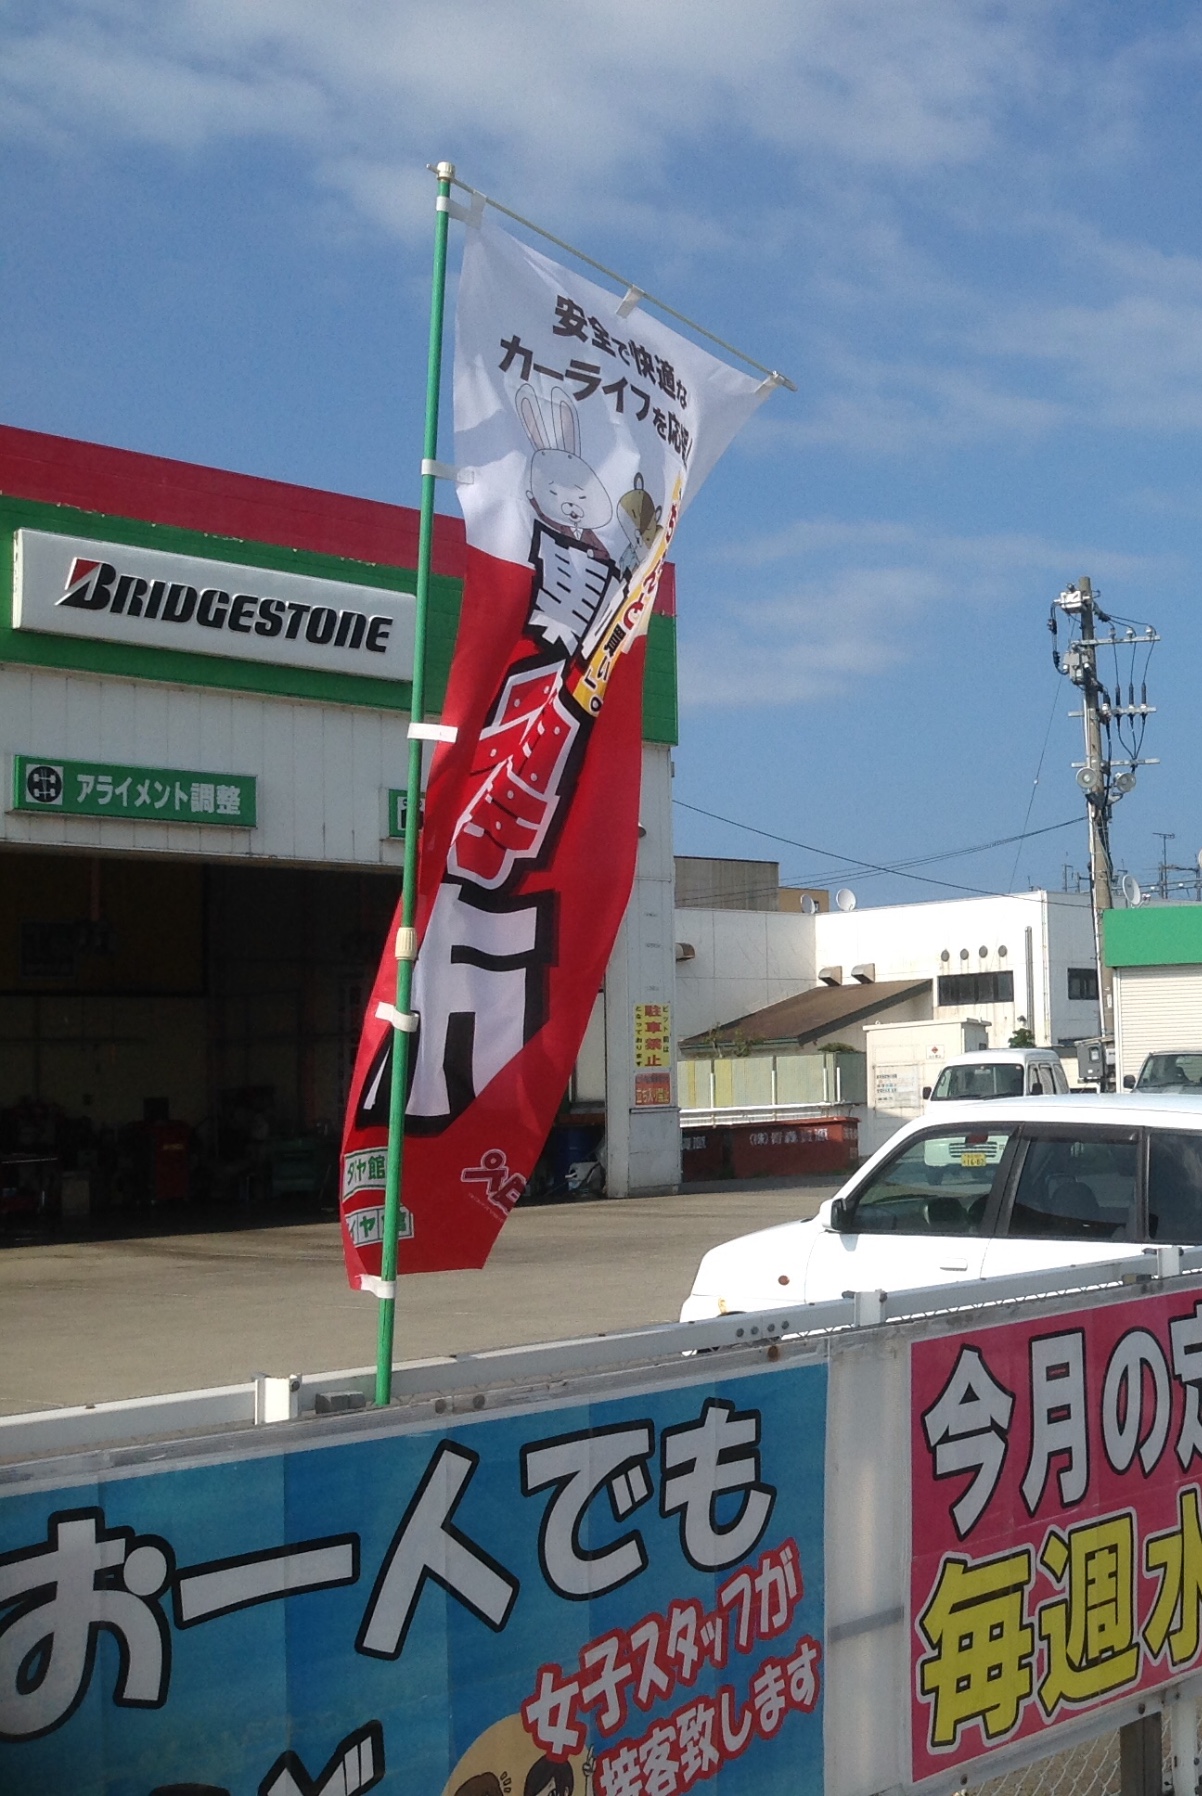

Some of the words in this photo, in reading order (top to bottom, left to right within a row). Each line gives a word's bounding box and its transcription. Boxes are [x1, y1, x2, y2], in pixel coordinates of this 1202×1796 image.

[56, 556, 394, 654] BRIDGESTONE
[76, 772, 242, 816] アライメント調整
[644, 1004, 662, 1067] 駐車禁止
[0, 1398, 777, 1745] お一人でも
[524, 1540, 804, 1763] 女子スタッフが
